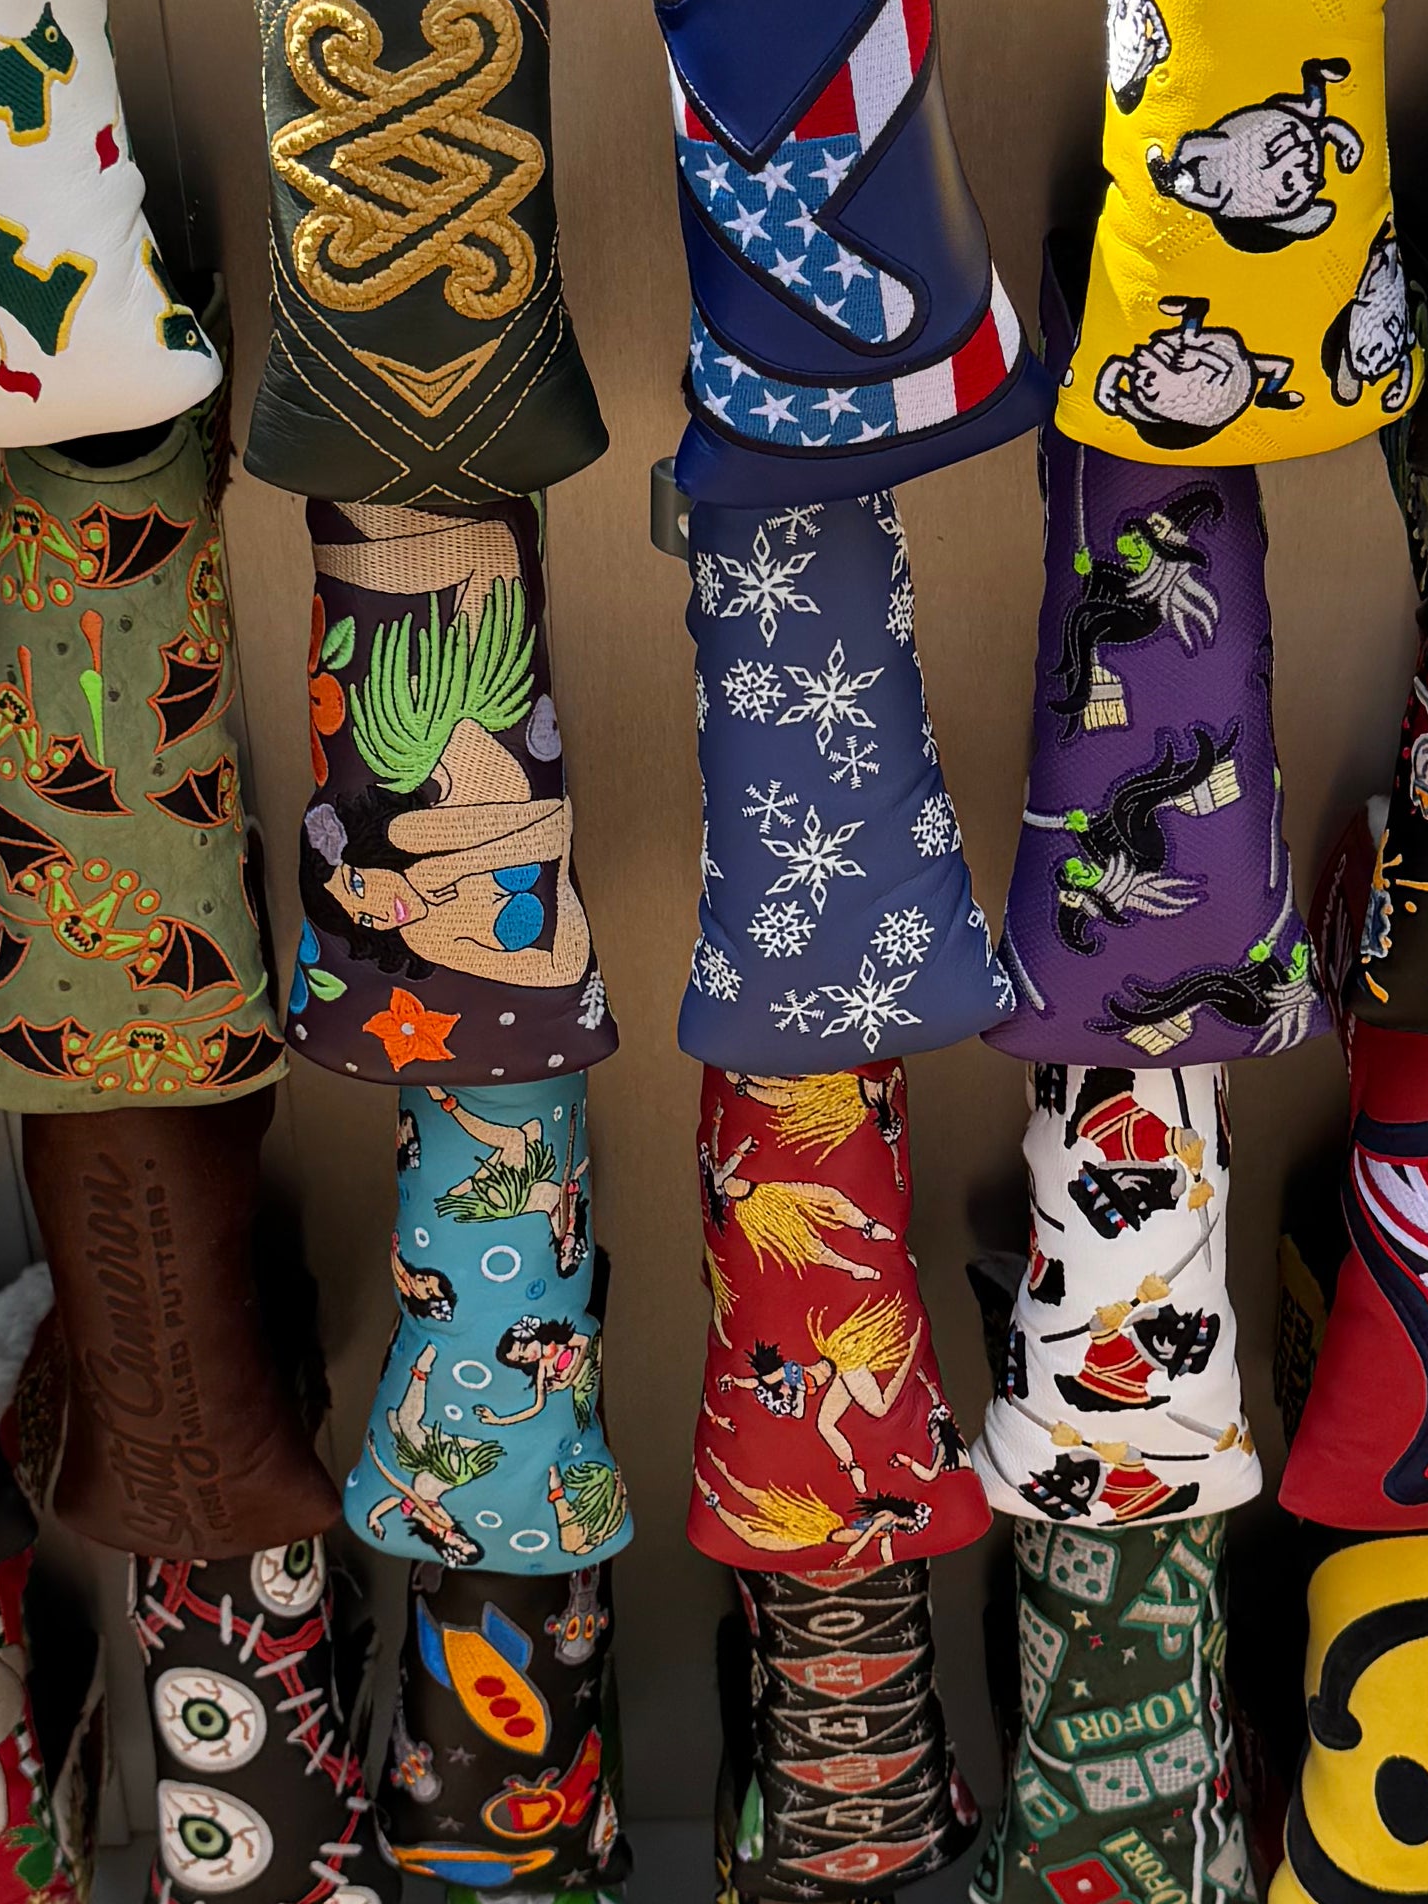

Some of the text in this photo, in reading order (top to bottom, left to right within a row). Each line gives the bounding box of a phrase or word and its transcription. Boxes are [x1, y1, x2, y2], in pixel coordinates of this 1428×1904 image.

[81, 1153, 164, 1416] Cameron
[145, 1183, 185, 1328] PUTTERS
[169, 1340, 204, 1442] MILLED
